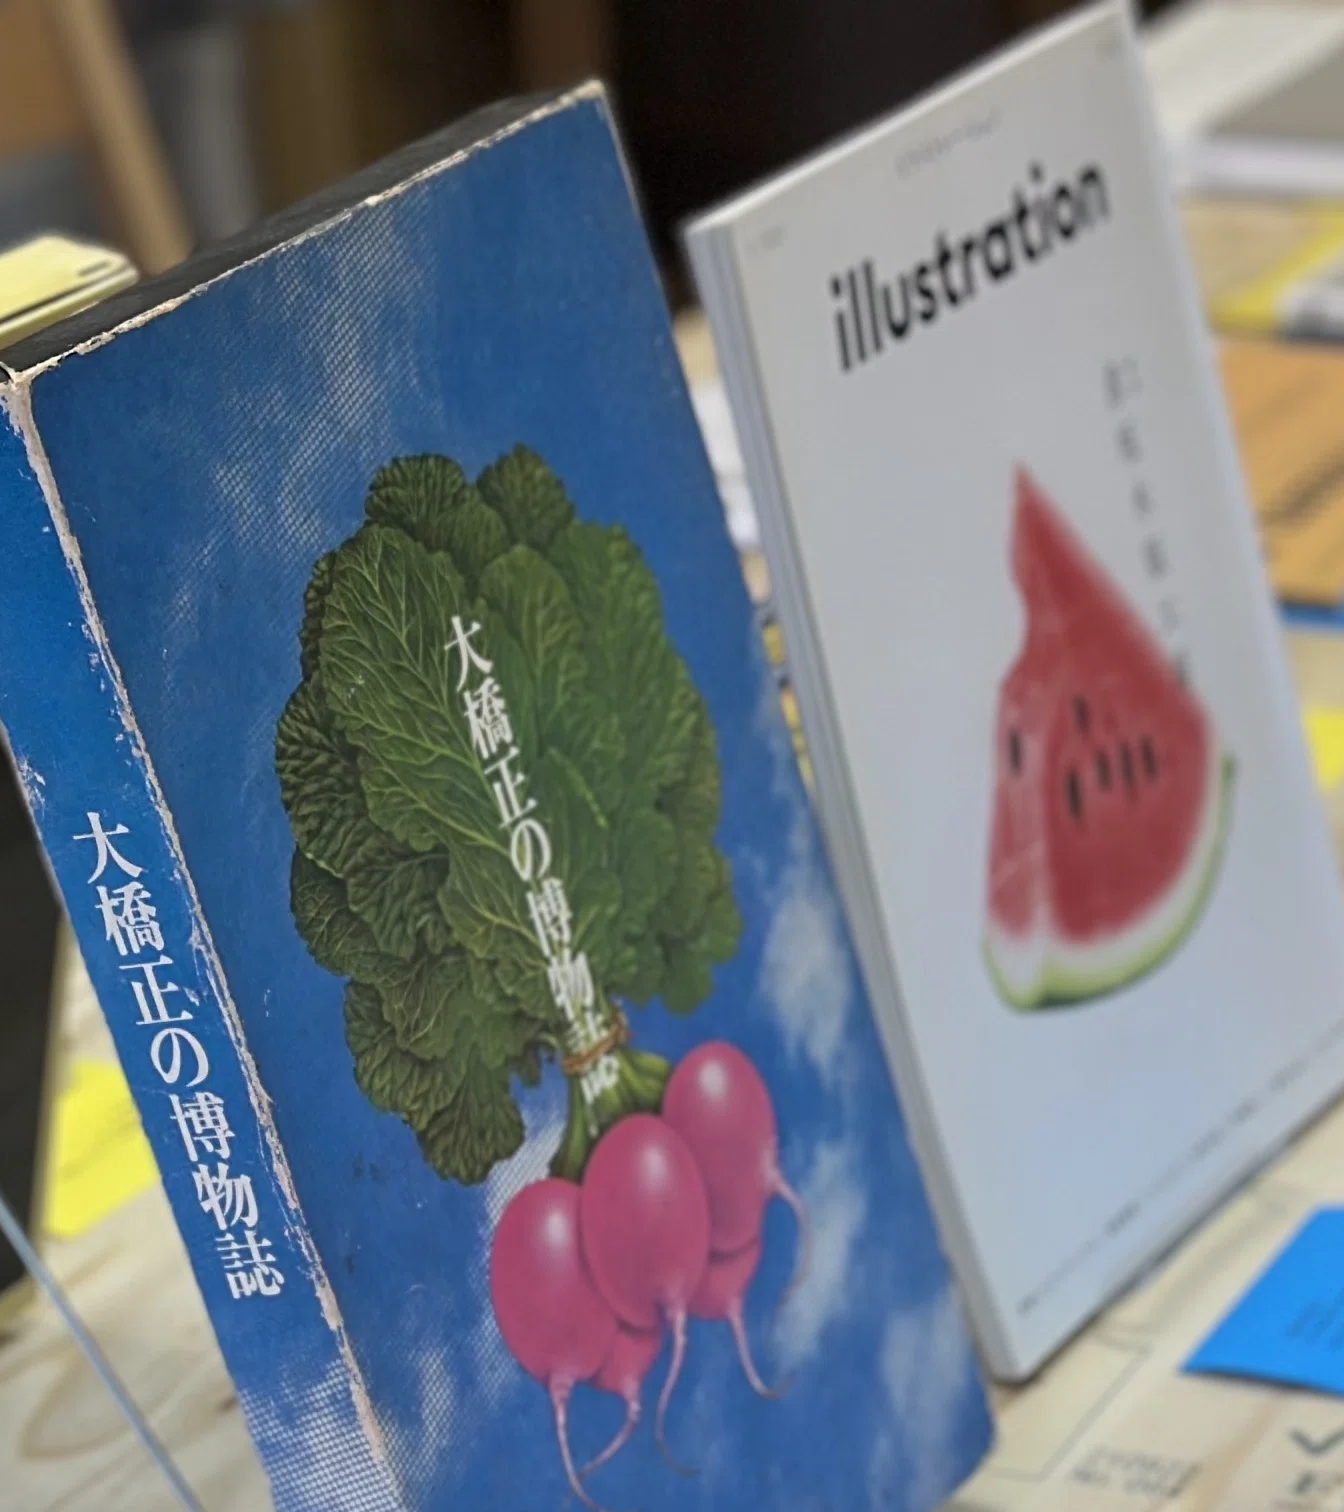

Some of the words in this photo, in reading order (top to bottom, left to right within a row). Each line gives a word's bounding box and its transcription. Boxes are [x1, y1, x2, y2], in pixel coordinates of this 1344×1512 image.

[830, 160, 1110, 371] illustration
[73, 812, 285, 1300] 大橋正の博物誌
